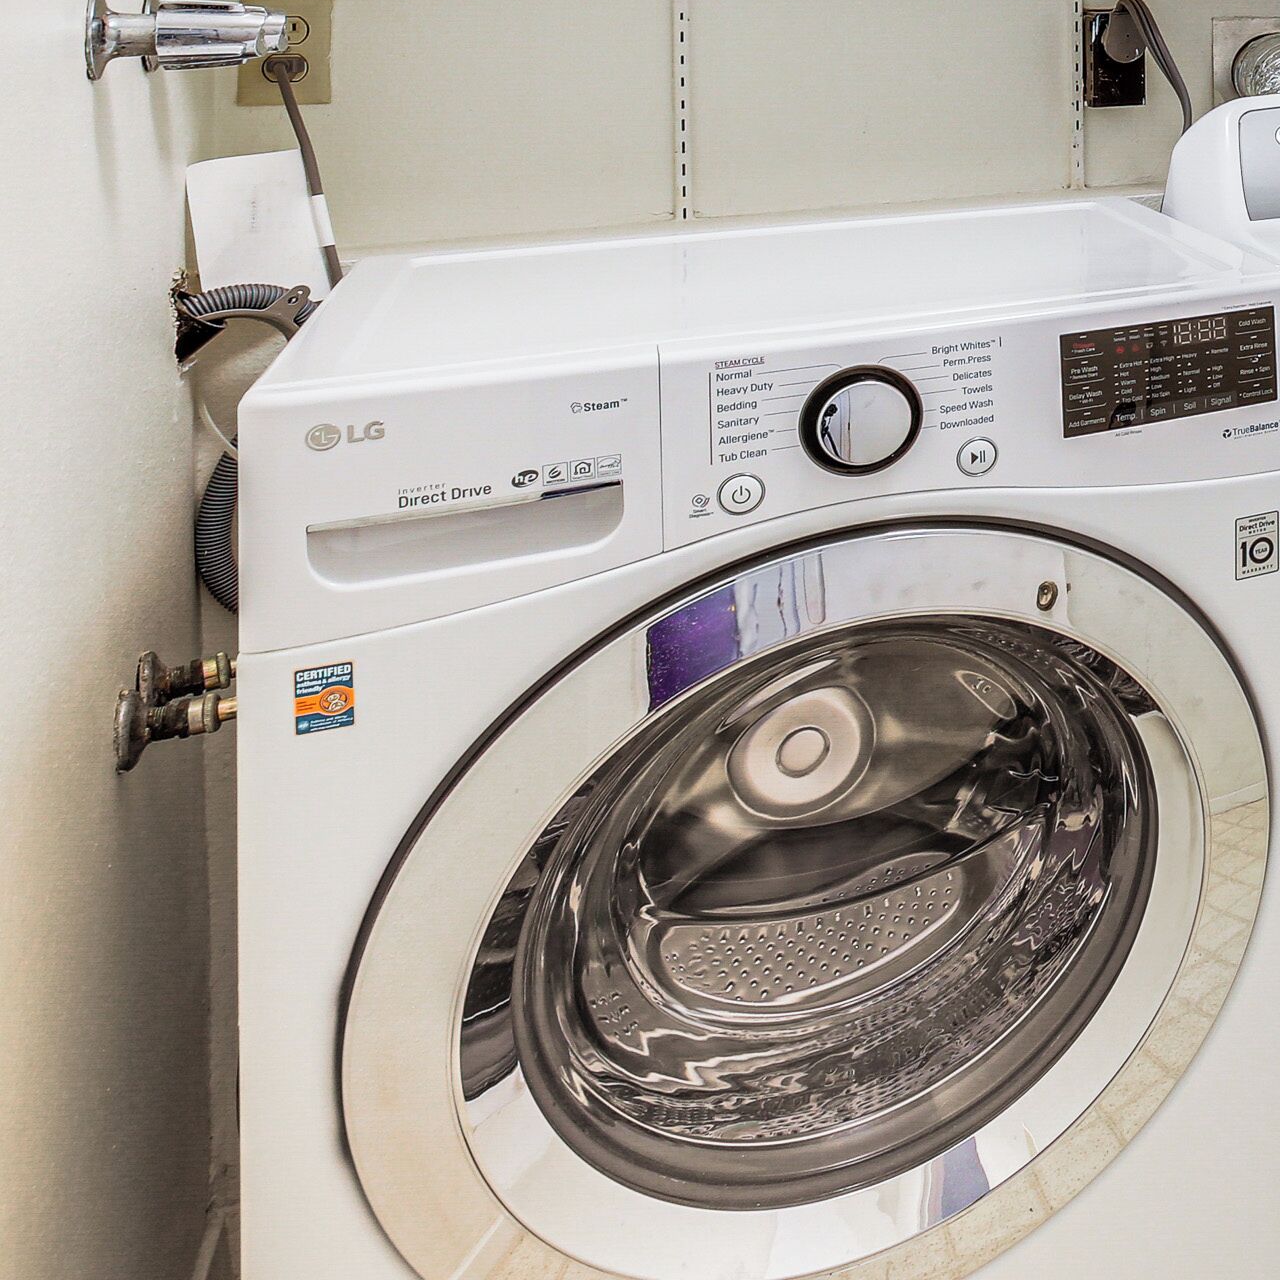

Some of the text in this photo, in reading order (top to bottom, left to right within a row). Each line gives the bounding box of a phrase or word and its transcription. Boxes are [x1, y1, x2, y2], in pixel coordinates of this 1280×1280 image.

[932, 344, 958, 354] Bright
[715, 357, 765, 368] STEAM CYCLE
[716, 370, 752, 382] Normal
[953, 370, 992, 381] Delicates
[716, 382, 773, 397] Heavy Duty
[962, 384, 992, 395] Towels
[1069, 390, 1102, 401] Delay Wash
[717, 400, 758, 413] Bedding
[940, 399, 993, 414] Speed Wash
[1184, 402, 1196, 410] Soil
[1211, 396, 1232, 406] Signal
[1150, 408, 1166, 416] Spin
[718, 416, 759, 429] Sanitary
[940, 415, 994, 430] Downloaded
[1081, 417, 1106, 426] Garments
[347, 421, 384, 443] LG
[719, 448, 767, 463] Tub Clean
[512, 470, 539, 488] he
[398, 483, 446, 495] Inverter
[399, 484, 492, 508] Direct Drive
[1240, 520, 1275, 532] Direct Drive
[1240, 537, 1274, 567] 10
[1242, 564, 1273, 574] WARRANTY
[296, 664, 351, 682] CERTIFIED
[296, 680, 321, 688] asthma
[328, 675, 351, 683] allergy
